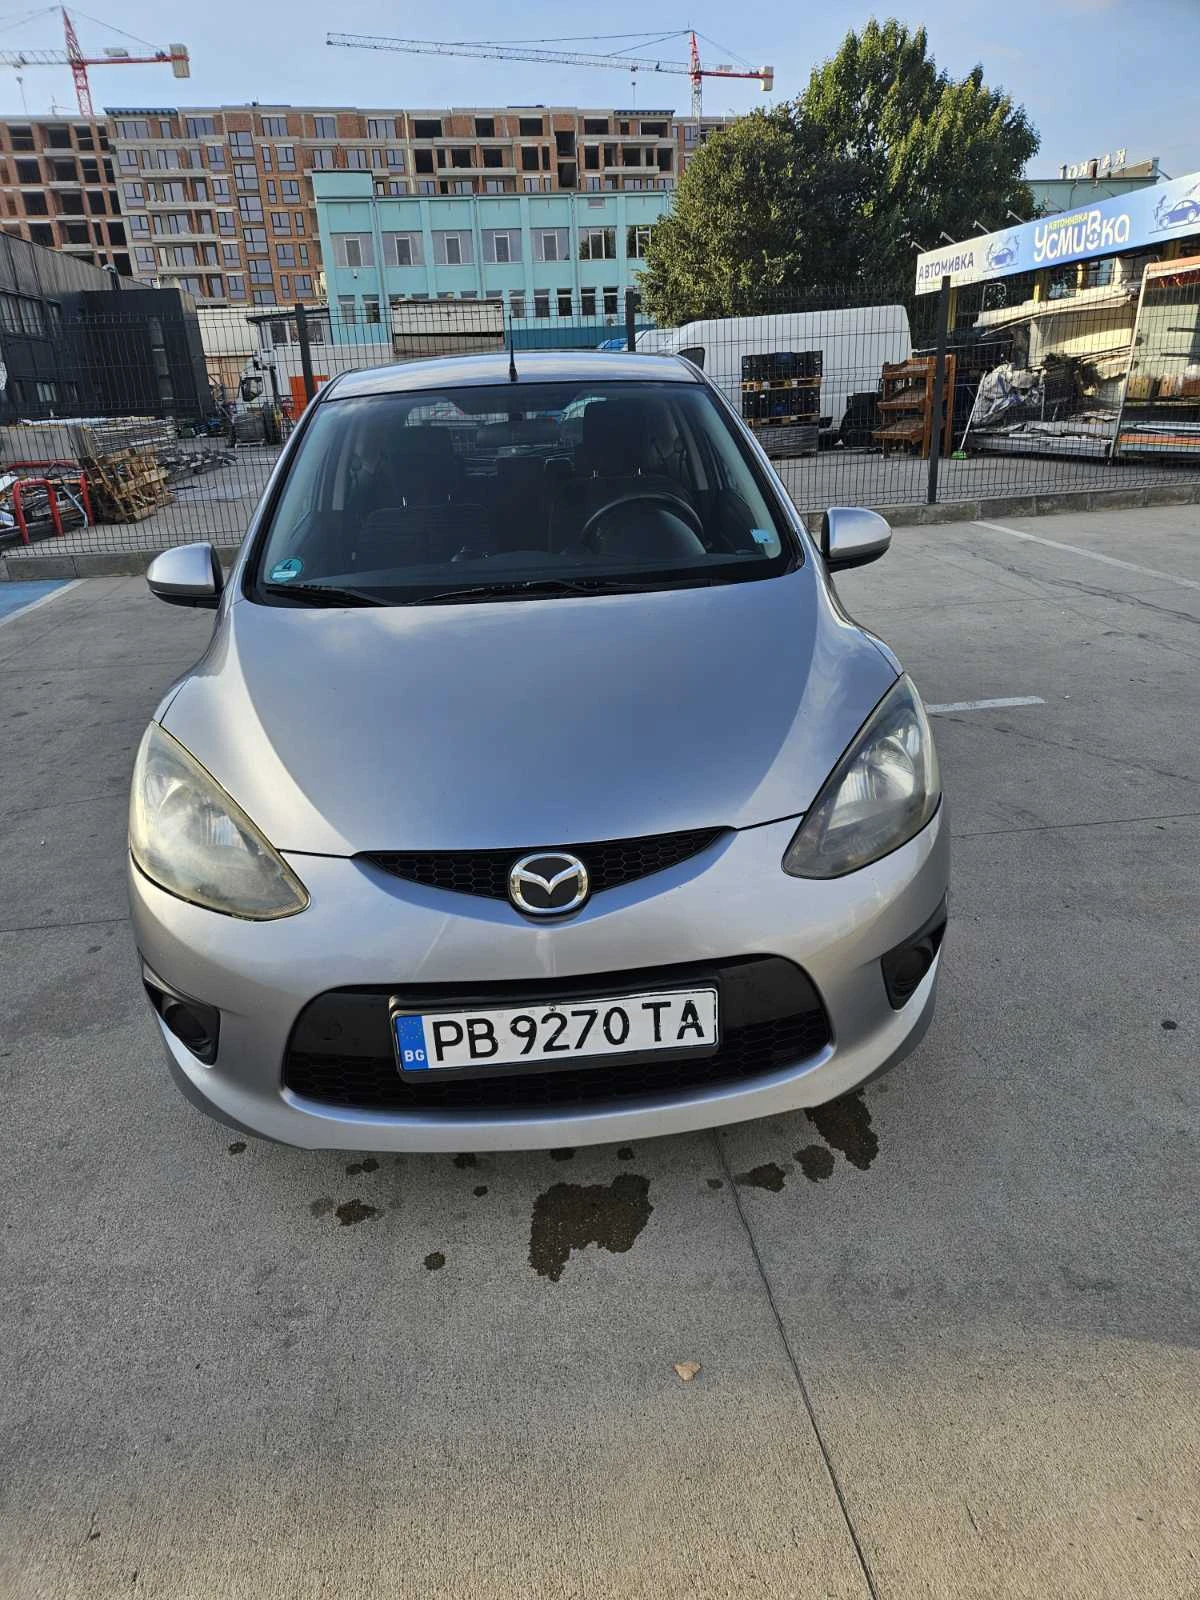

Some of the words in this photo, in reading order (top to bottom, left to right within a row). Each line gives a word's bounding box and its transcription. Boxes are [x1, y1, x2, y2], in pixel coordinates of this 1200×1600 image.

[918, 251, 974, 280] АВТОМИВКА
[431, 1017, 500, 1062] PB
[509, 1005, 631, 1056] 9270
[641, 999, 706, 1042] TA
[404, 1049, 426, 1063] BG
